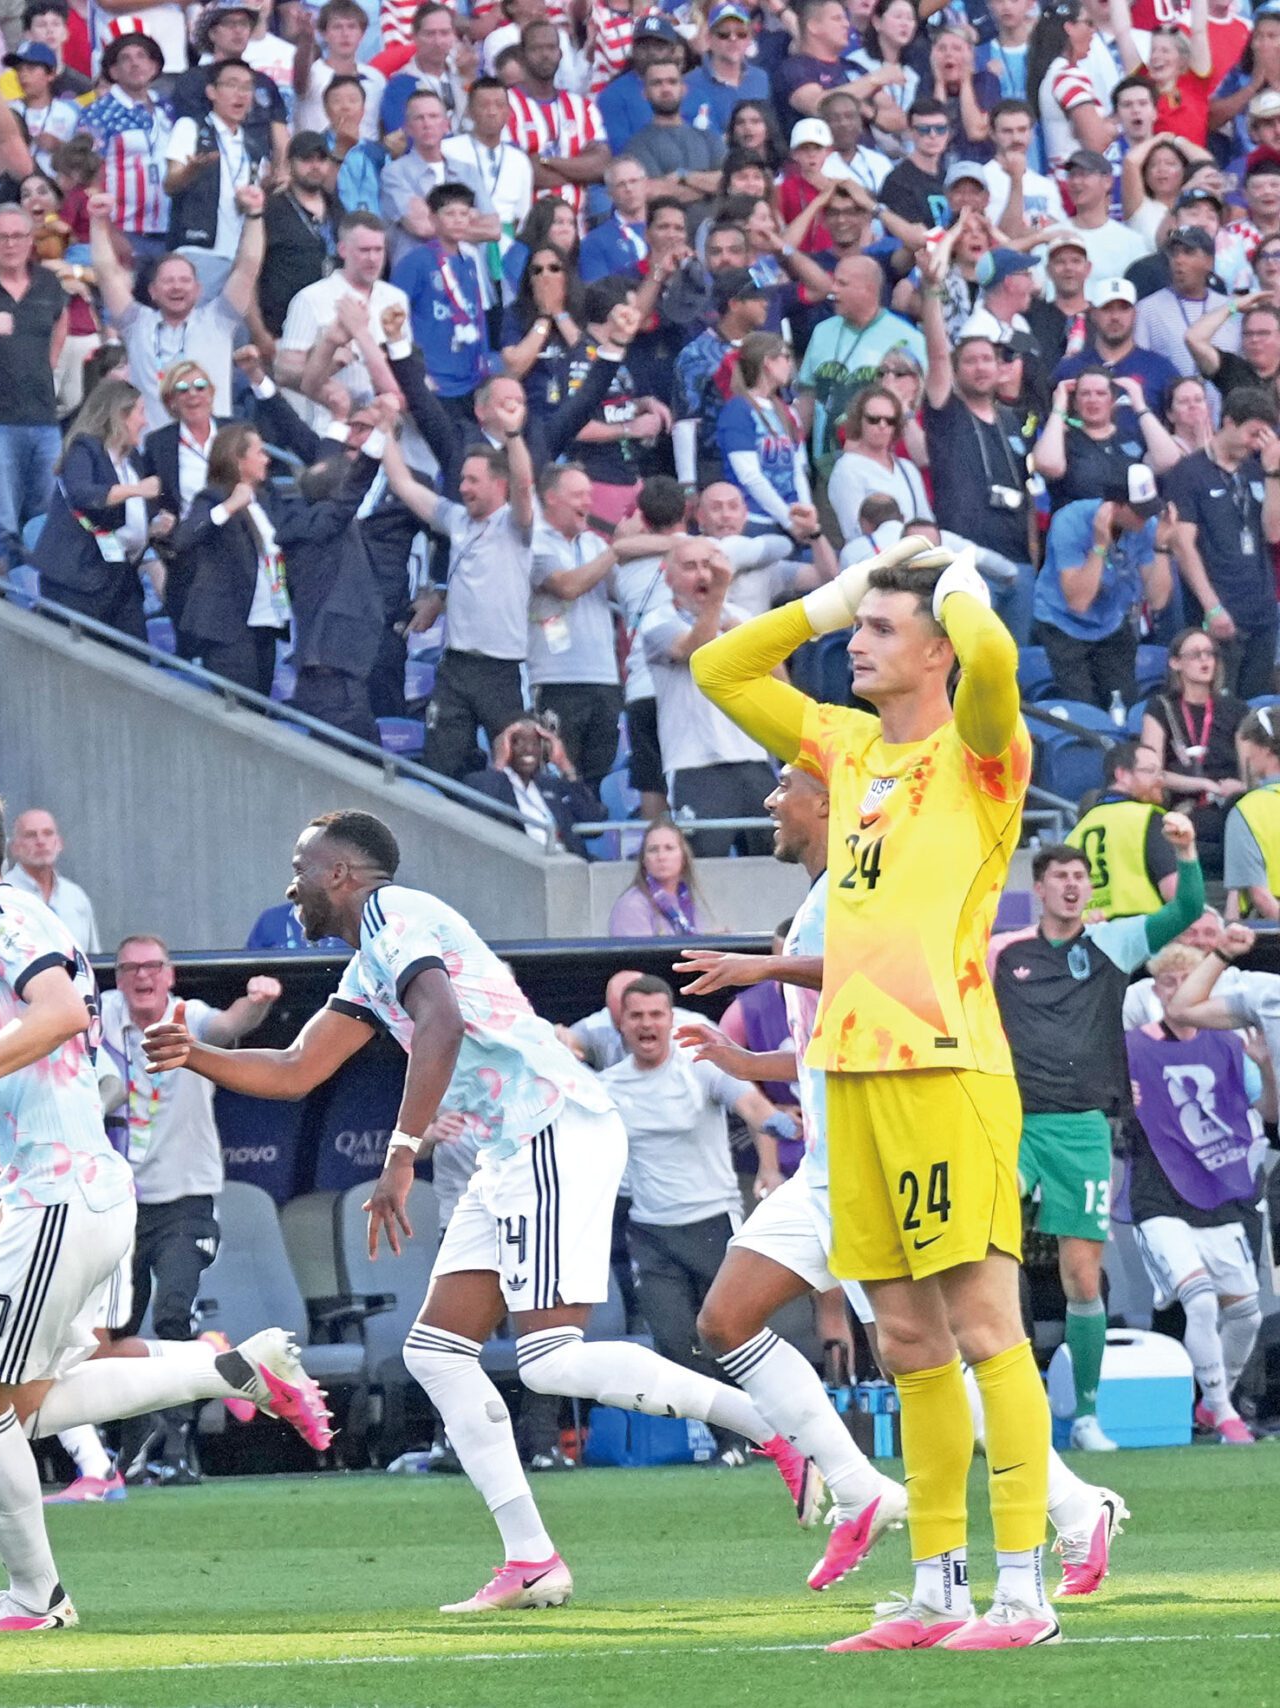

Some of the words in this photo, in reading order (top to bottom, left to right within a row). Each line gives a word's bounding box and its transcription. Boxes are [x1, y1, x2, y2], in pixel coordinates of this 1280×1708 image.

[869, 777, 896, 796] USA
[839, 833, 885, 889] 24
[899, 1161, 951, 1231] 24
[1084, 1180, 1110, 1214] 13
